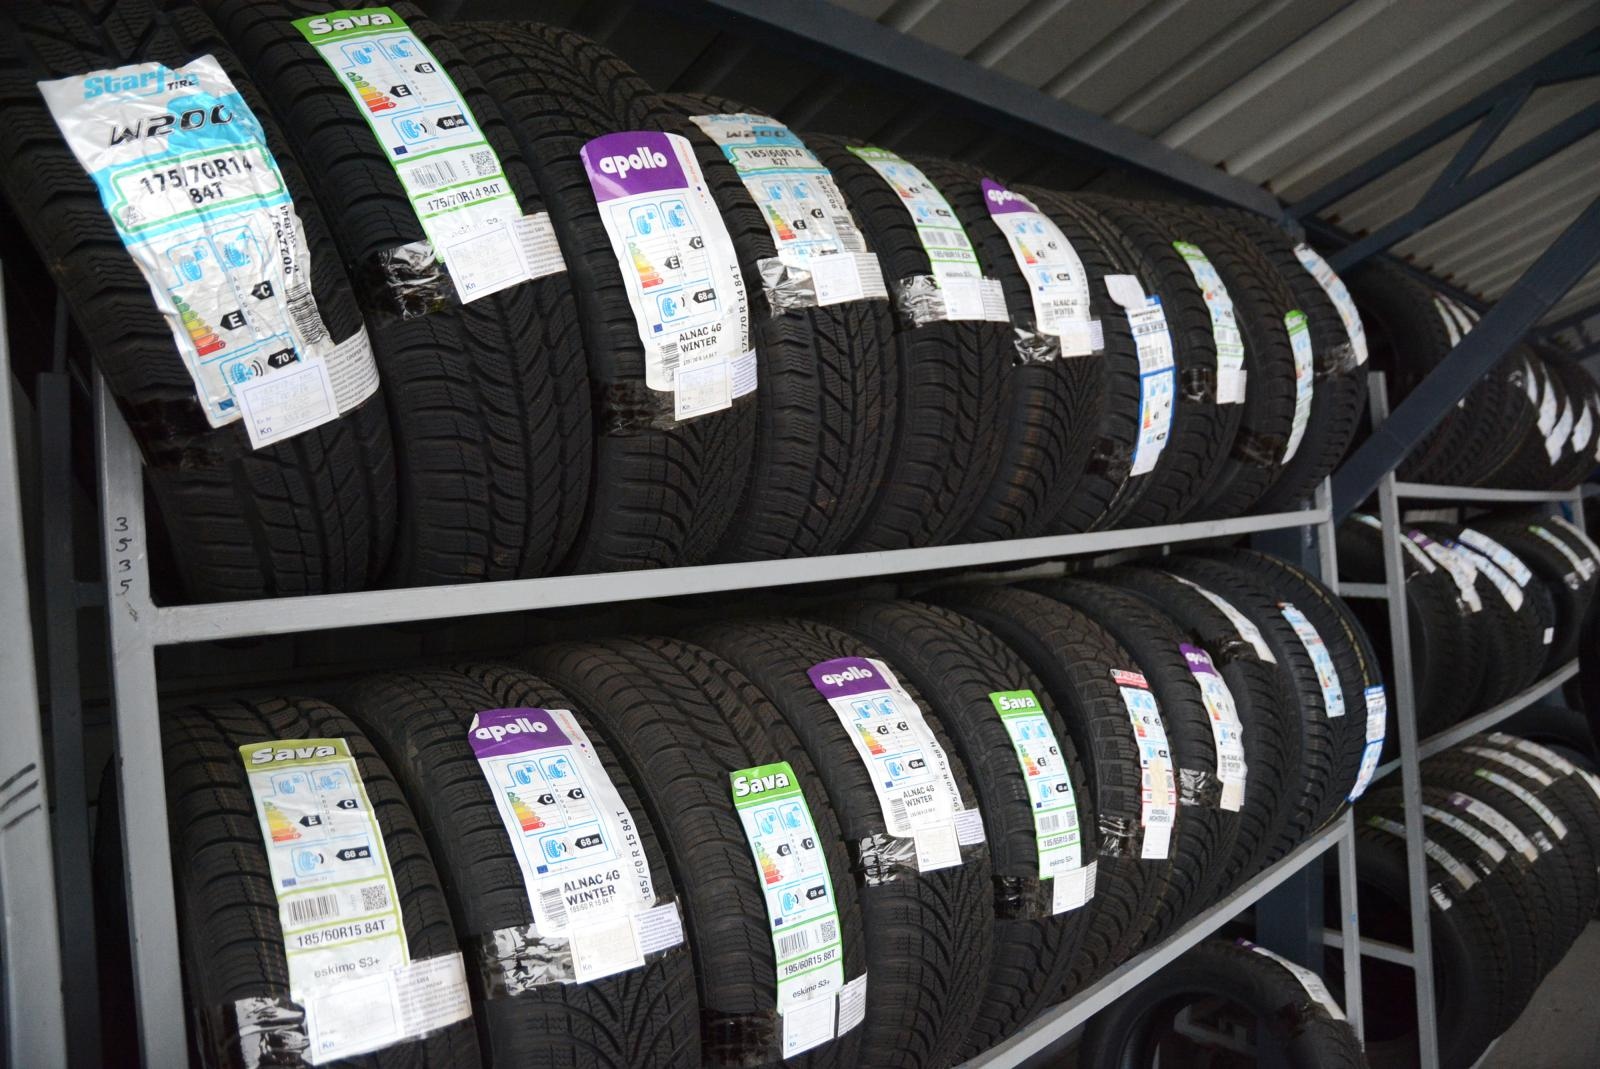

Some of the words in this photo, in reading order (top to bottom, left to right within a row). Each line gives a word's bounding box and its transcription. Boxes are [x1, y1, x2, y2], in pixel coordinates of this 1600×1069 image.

[308, 12, 392, 35] Sava
[423, 63, 433, 73] B
[84, 64, 199, 99] Starf
[399, 86, 408, 96] E
[600, 147, 668, 179] apollo
[140, 155, 252, 194] 175/70R14
[190, 181, 224, 204] 84T
[427, 188, 480, 212] 175/70R14
[483, 183, 501, 197] 84T
[988, 189, 1024, 205] apo
[798, 220, 806, 230] E
[693, 237, 703, 248] C
[670, 257, 680, 268] E
[732, 273, 743, 287] 84
[260, 283, 271, 297] C
[697, 291, 707, 301] 68
[738, 290, 745, 303] 14
[739, 305, 746, 313] R
[228, 312, 243, 328] E
[679, 326, 709, 342] ALNAC
[711, 323, 722, 333] 4G
[740, 315, 748, 353] 175/70
[680, 336, 717, 353] WINTER
[275, 352, 290, 365] 70
[821, 666, 873, 687] apollo
[999, 695, 1036, 711] Sava
[475, 718, 548, 742] apollo
[251, 745, 337, 765] Sava
[733, 772, 791, 797] Sava
[543, 794, 554, 804] C
[573, 789, 583, 799] C
[903, 787, 925, 798] ALNAC
[344, 800, 355, 808] C
[905, 794, 933, 807] WINTER
[308, 816, 319, 825] E
[620, 819, 632, 831] 84
[580, 838, 592, 847] 68
[625, 834, 637, 846] 15
[806, 839, 814, 848] C
[631, 849, 641, 858] R
[781, 845, 789, 854] C
[563, 873, 604, 893] ALNAC
[605, 870, 620, 881] 4G
[634, 860, 651, 900] 185/60
[566, 884, 617, 906] WINTER
[297, 924, 362, 947] 185/60R15
[365, 919, 386, 934] 84T
[314, 961, 356, 978] eskimo
[359, 956, 381, 968] S3+
[784, 955, 822, 976] 195/60R15
[823, 949, 836, 961] 88T
[792, 984, 817, 998] eskimo
